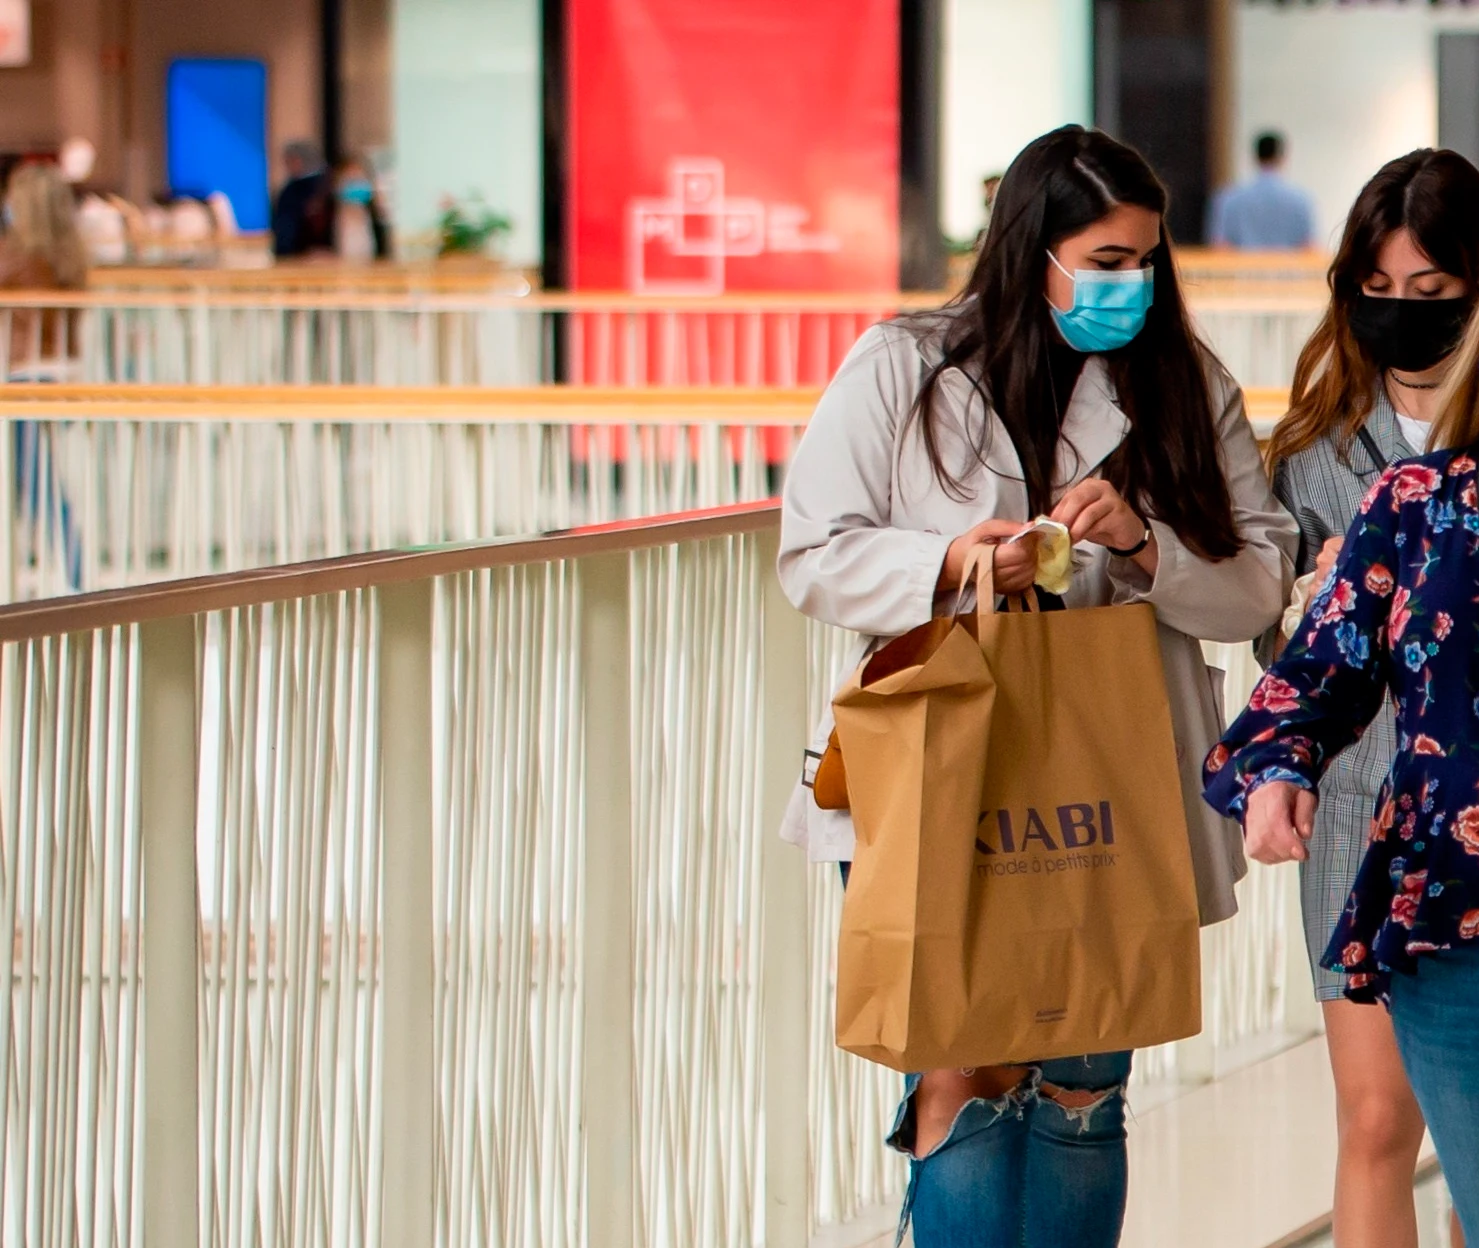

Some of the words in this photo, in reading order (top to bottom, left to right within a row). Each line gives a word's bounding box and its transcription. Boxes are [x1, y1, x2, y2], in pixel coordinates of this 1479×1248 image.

[976, 857, 1027, 878] mode
[1045, 854, 1089, 876] petits
[1092, 851, 1116, 874] prix
